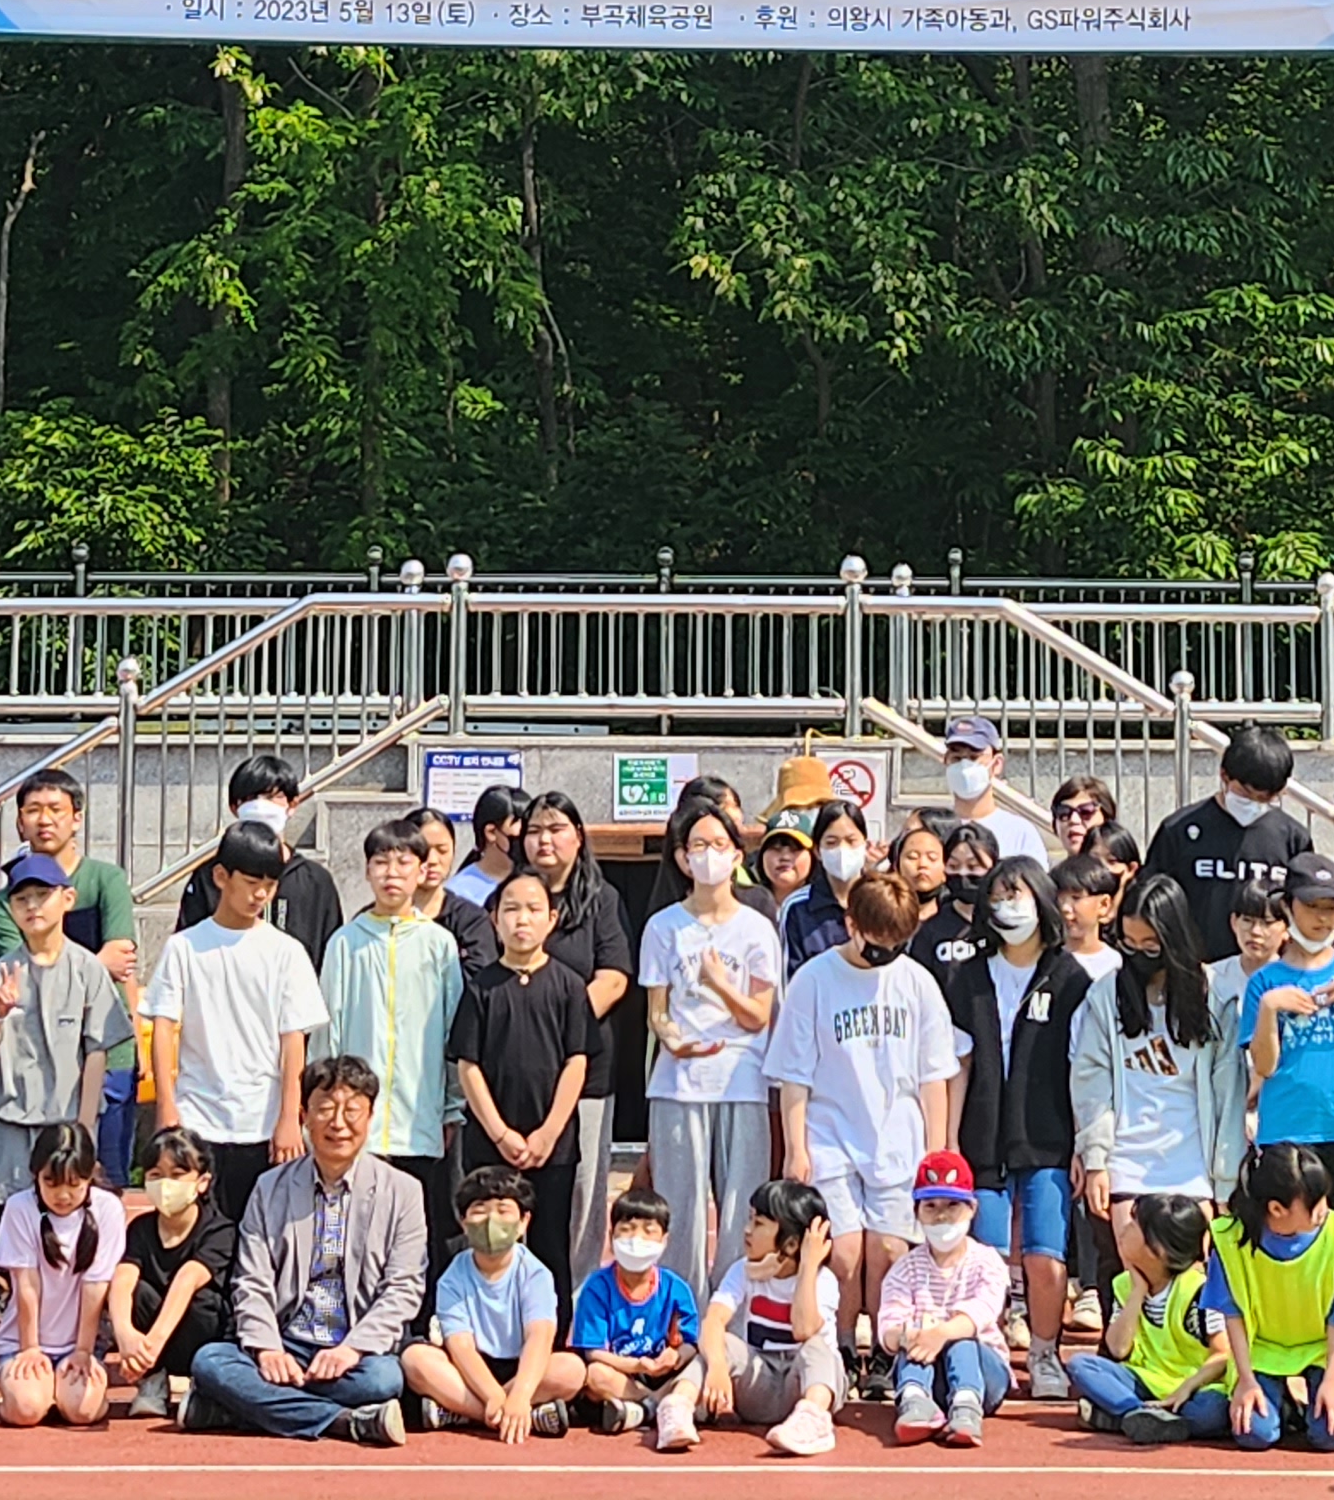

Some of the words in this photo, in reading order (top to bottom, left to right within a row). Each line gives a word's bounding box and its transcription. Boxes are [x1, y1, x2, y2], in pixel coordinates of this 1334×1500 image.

[253, 0, 330, 24] 2023년
[338, 0, 374, 25] 5월
[384, 1, 476, 28] 13일(토)
[508, 3, 553, 28] 장소
[580, 4, 713, 30] 부곡체육공원
[753, 5, 798, 31] 후원
[826, 6, 891, 32] 의왕시
[901, 7, 1018, 33] 가족아동과,
[1027, 7, 1191, 32] GS파워주식회사
[883, 1005, 908, 1040] BAY
